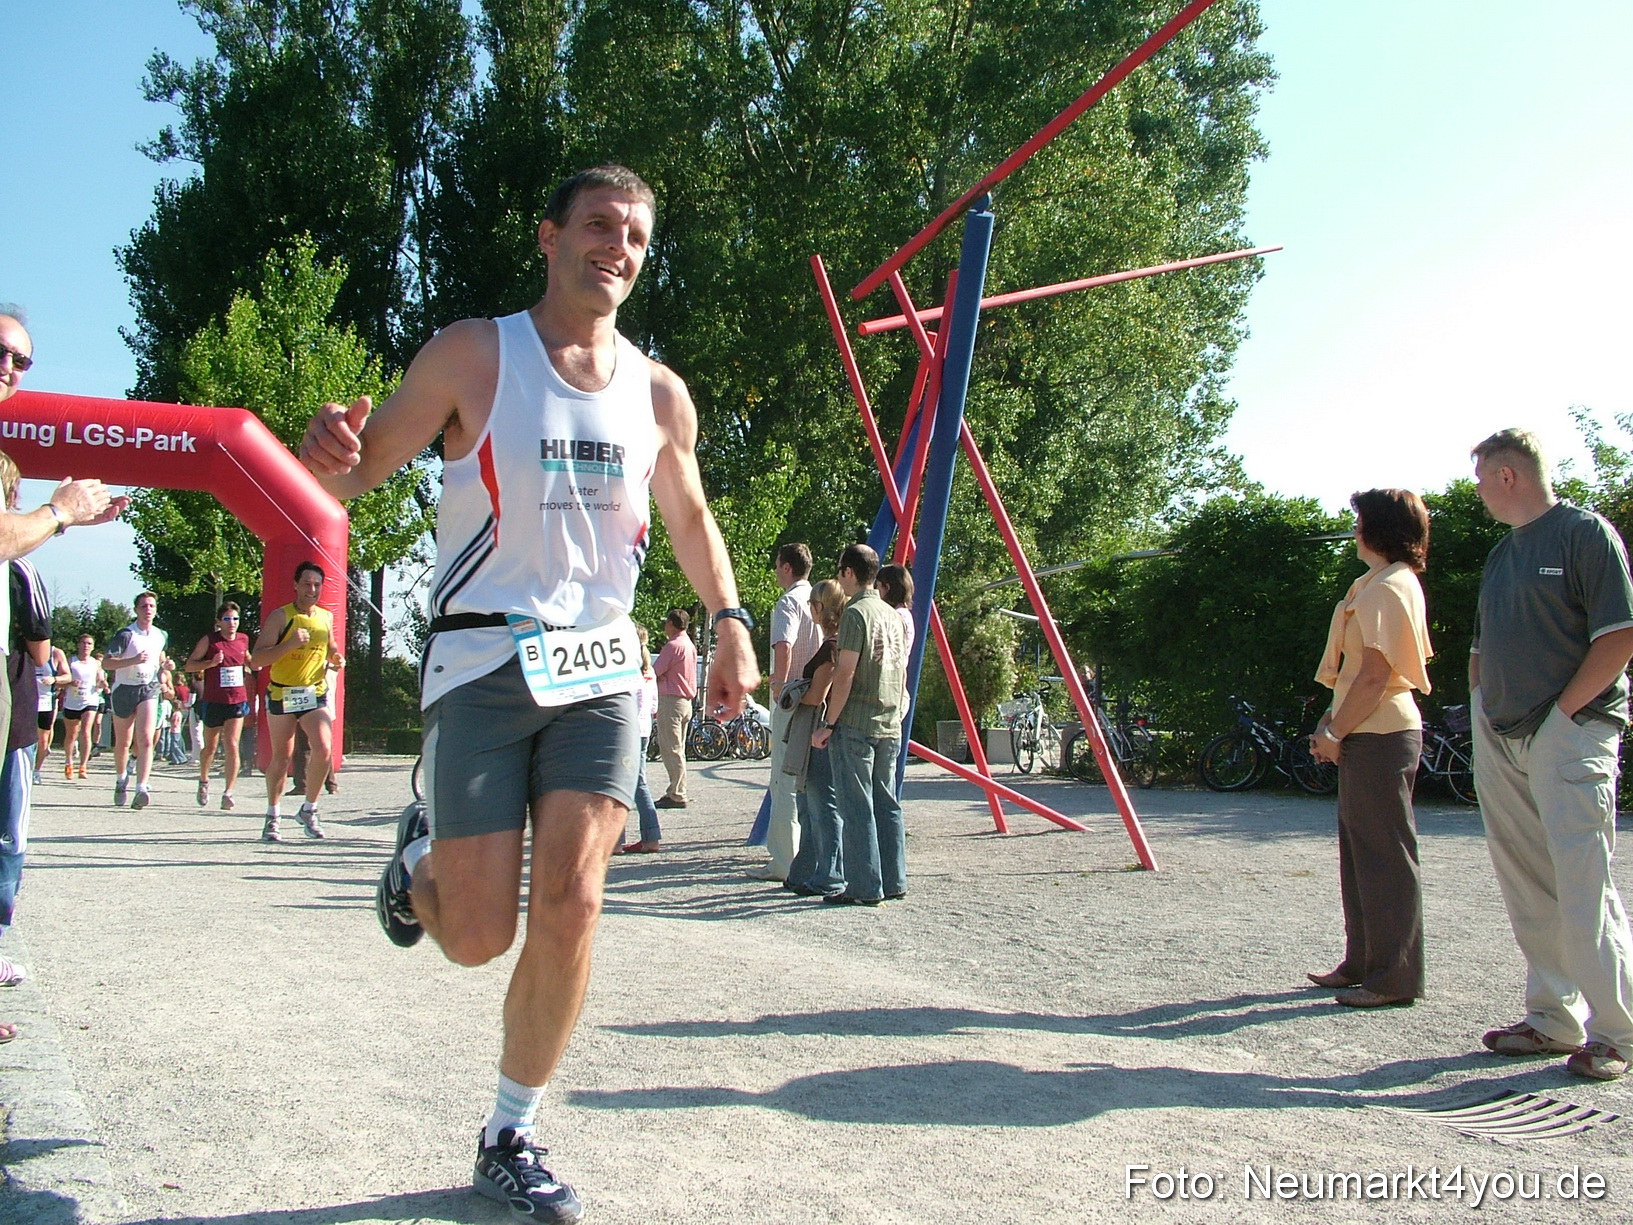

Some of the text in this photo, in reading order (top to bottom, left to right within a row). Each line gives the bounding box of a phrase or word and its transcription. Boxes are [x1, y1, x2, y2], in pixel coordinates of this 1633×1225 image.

[2, 421, 197, 453] ung LGS-Park
[541, 439, 625, 465] HUBER
[540, 502, 573, 510] moves
[577, 502, 590, 510] te
[526, 638, 626, 676] B 2405
[292, 697, 309, 705] 335
